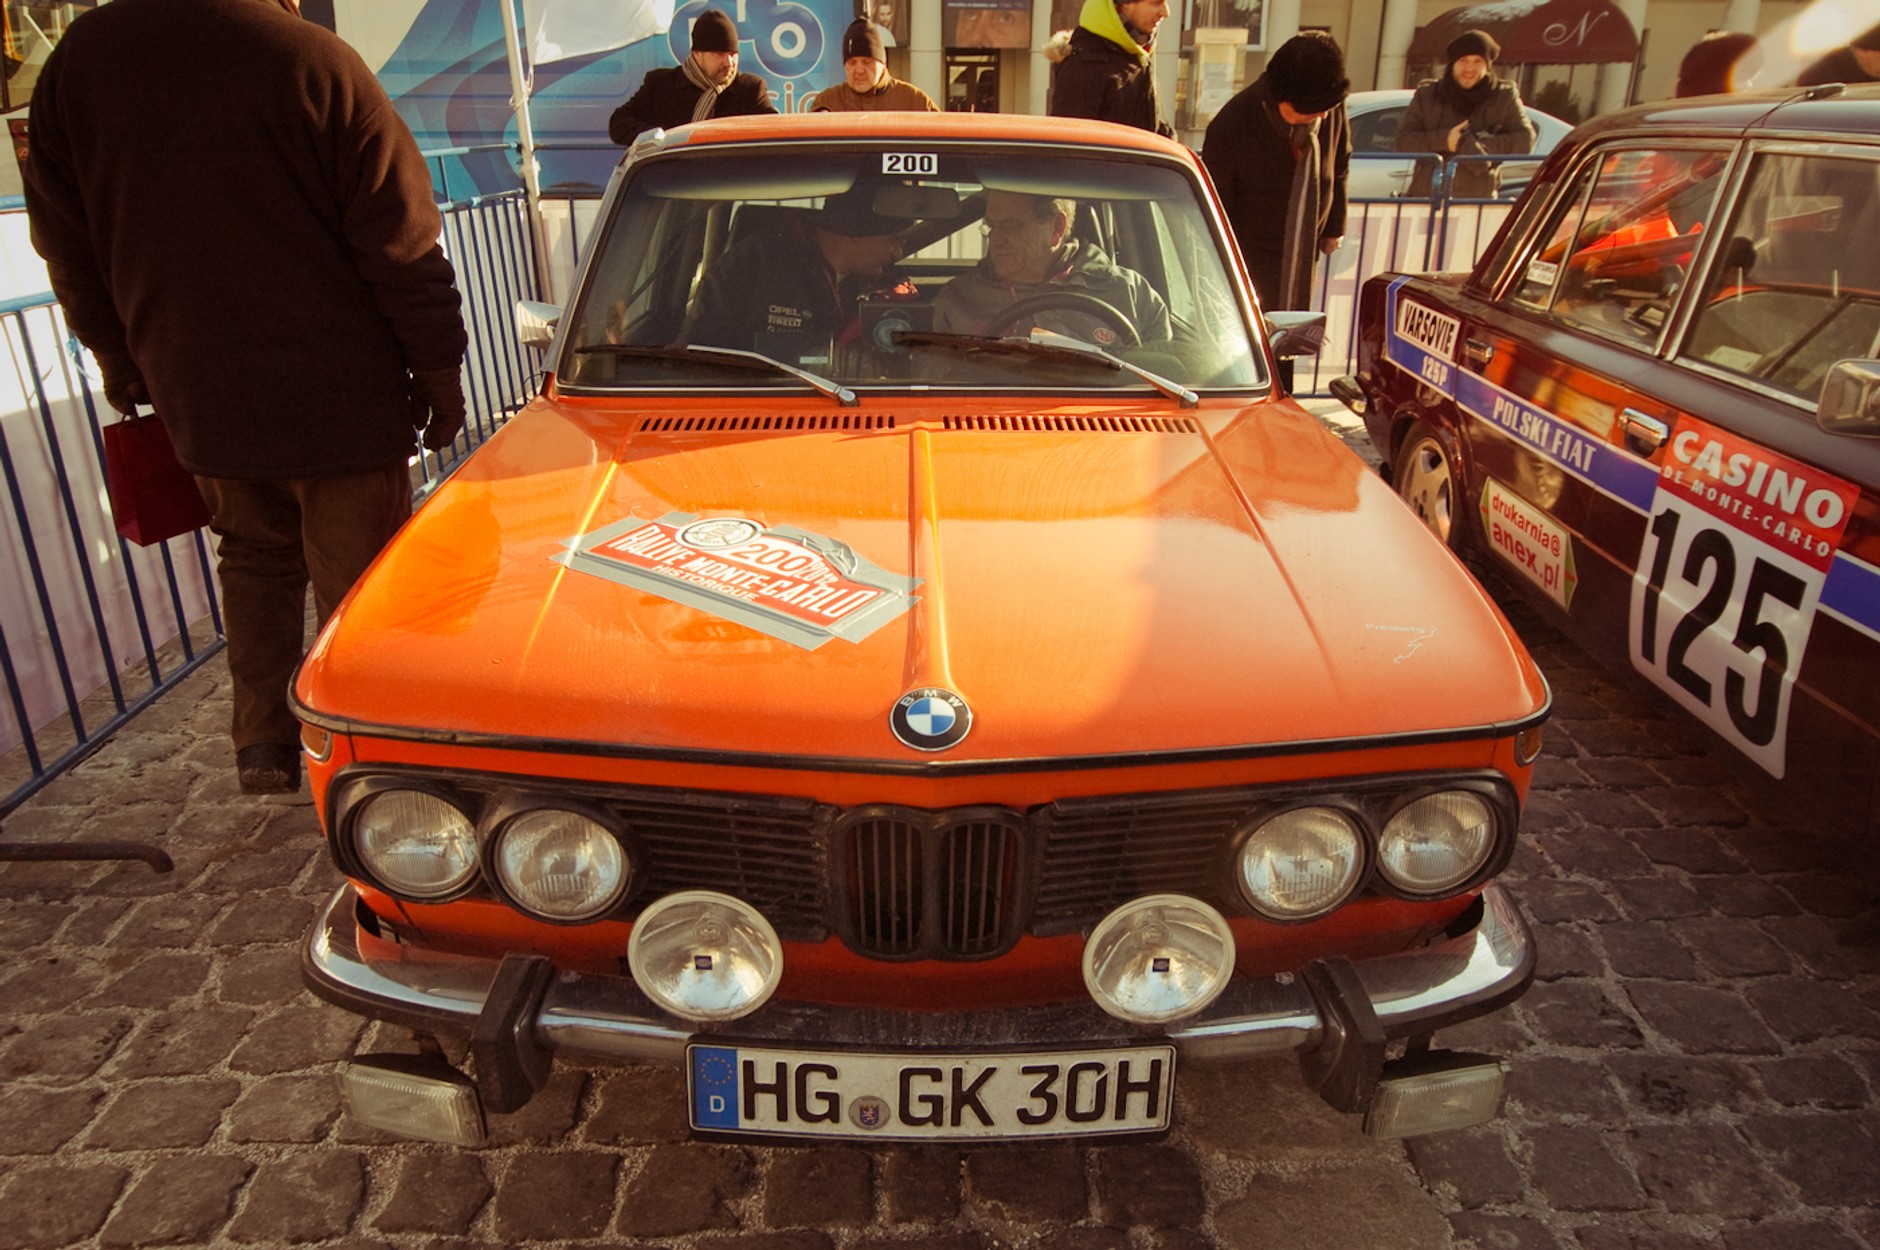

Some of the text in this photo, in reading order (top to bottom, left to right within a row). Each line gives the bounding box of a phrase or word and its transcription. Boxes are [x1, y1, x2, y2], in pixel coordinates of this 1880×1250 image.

[1543, 10, 1609, 47] N
[887, 155, 932, 172] 200
[769, 304, 801, 317] OPEL
[1403, 303, 1455, 354] VARSOVIE
[1422, 355, 1448, 387] 125P
[1492, 395, 1597, 473] POLSKI FIAT
[1672, 430, 1844, 529] CASINO
[1492, 493, 1560, 557] drukarnia@
[1663, 464, 1831, 557] DE MONTE-CARLO
[607, 524, 696, 564] RALLYE
[680, 556, 878, 618] MONTE-CARLO
[652, 564, 760, 600] HISTORIQUE
[730, 543, 813, 572] 200
[1492, 522, 1560, 591] anex.pl
[1641, 508, 1808, 747] 125
[900, 689, 963, 708] BMW
[709, 1096, 725, 1113] D
[742, 1060, 840, 1123] HG
[899, 1063, 997, 1126] GK
[1016, 1059, 1162, 1124] 30H
